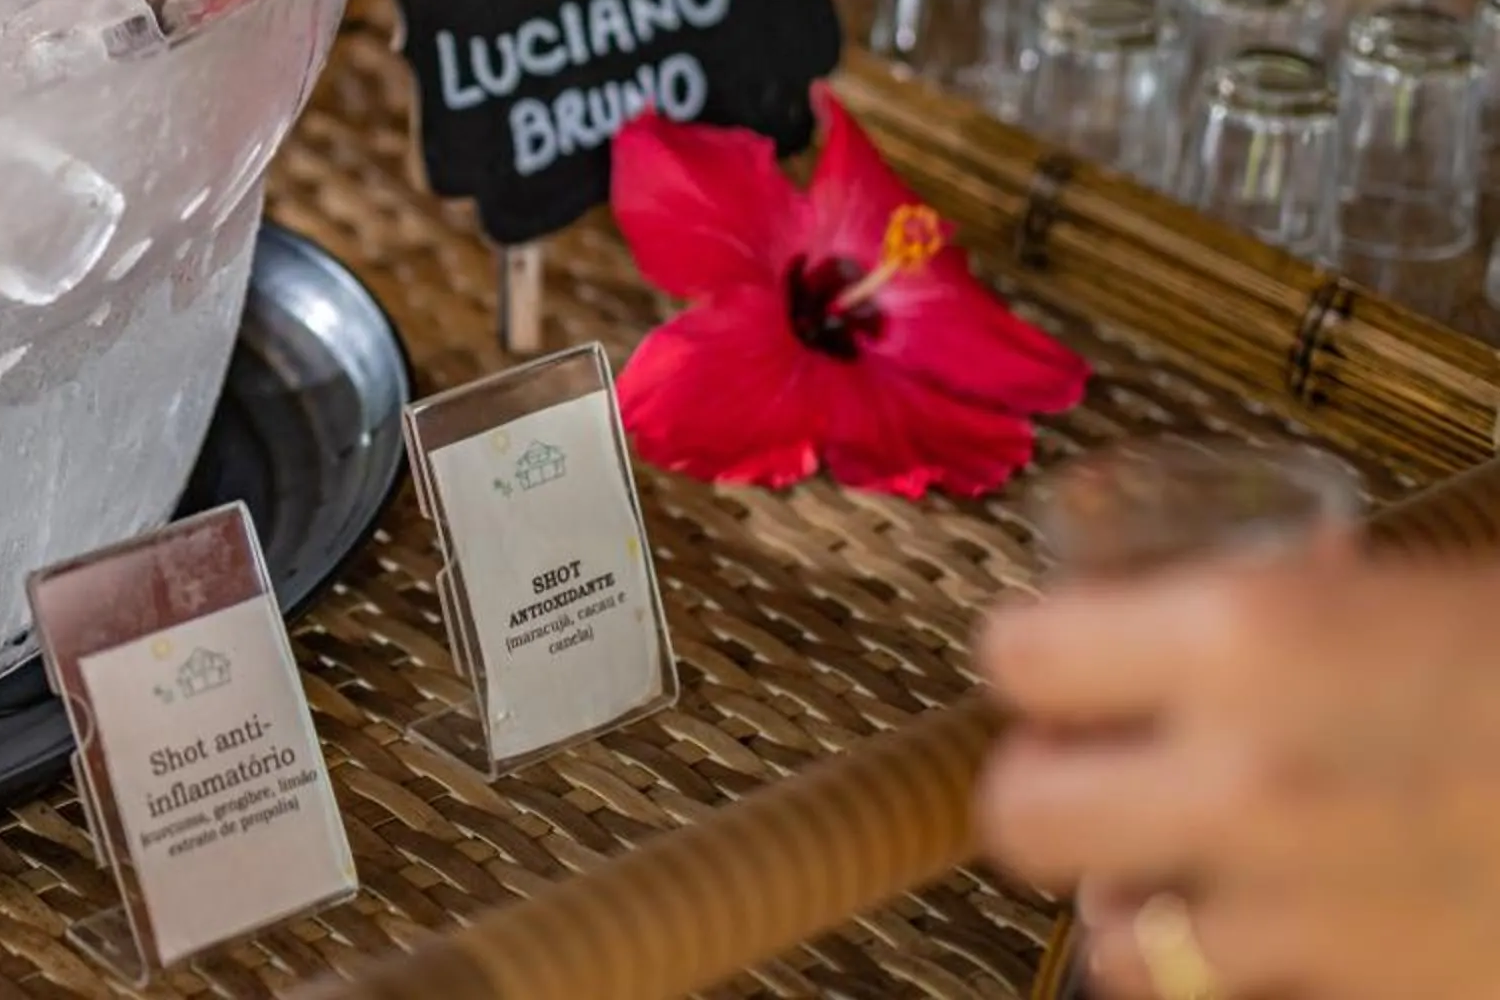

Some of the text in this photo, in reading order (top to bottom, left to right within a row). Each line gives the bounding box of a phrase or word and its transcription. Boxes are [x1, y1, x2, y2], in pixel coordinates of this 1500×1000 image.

[508, 53, 707, 176] BRUNO
[508, 572, 616, 629] ANTIOXIDANTE
[532, 560, 582, 595] SHOT
[577, 599, 616, 621] cacau
[617, 591, 626, 604] e
[149, 713, 274, 777] Shot anti-
[147, 745, 297, 819] inflamatório
[219, 820, 238, 838] de
